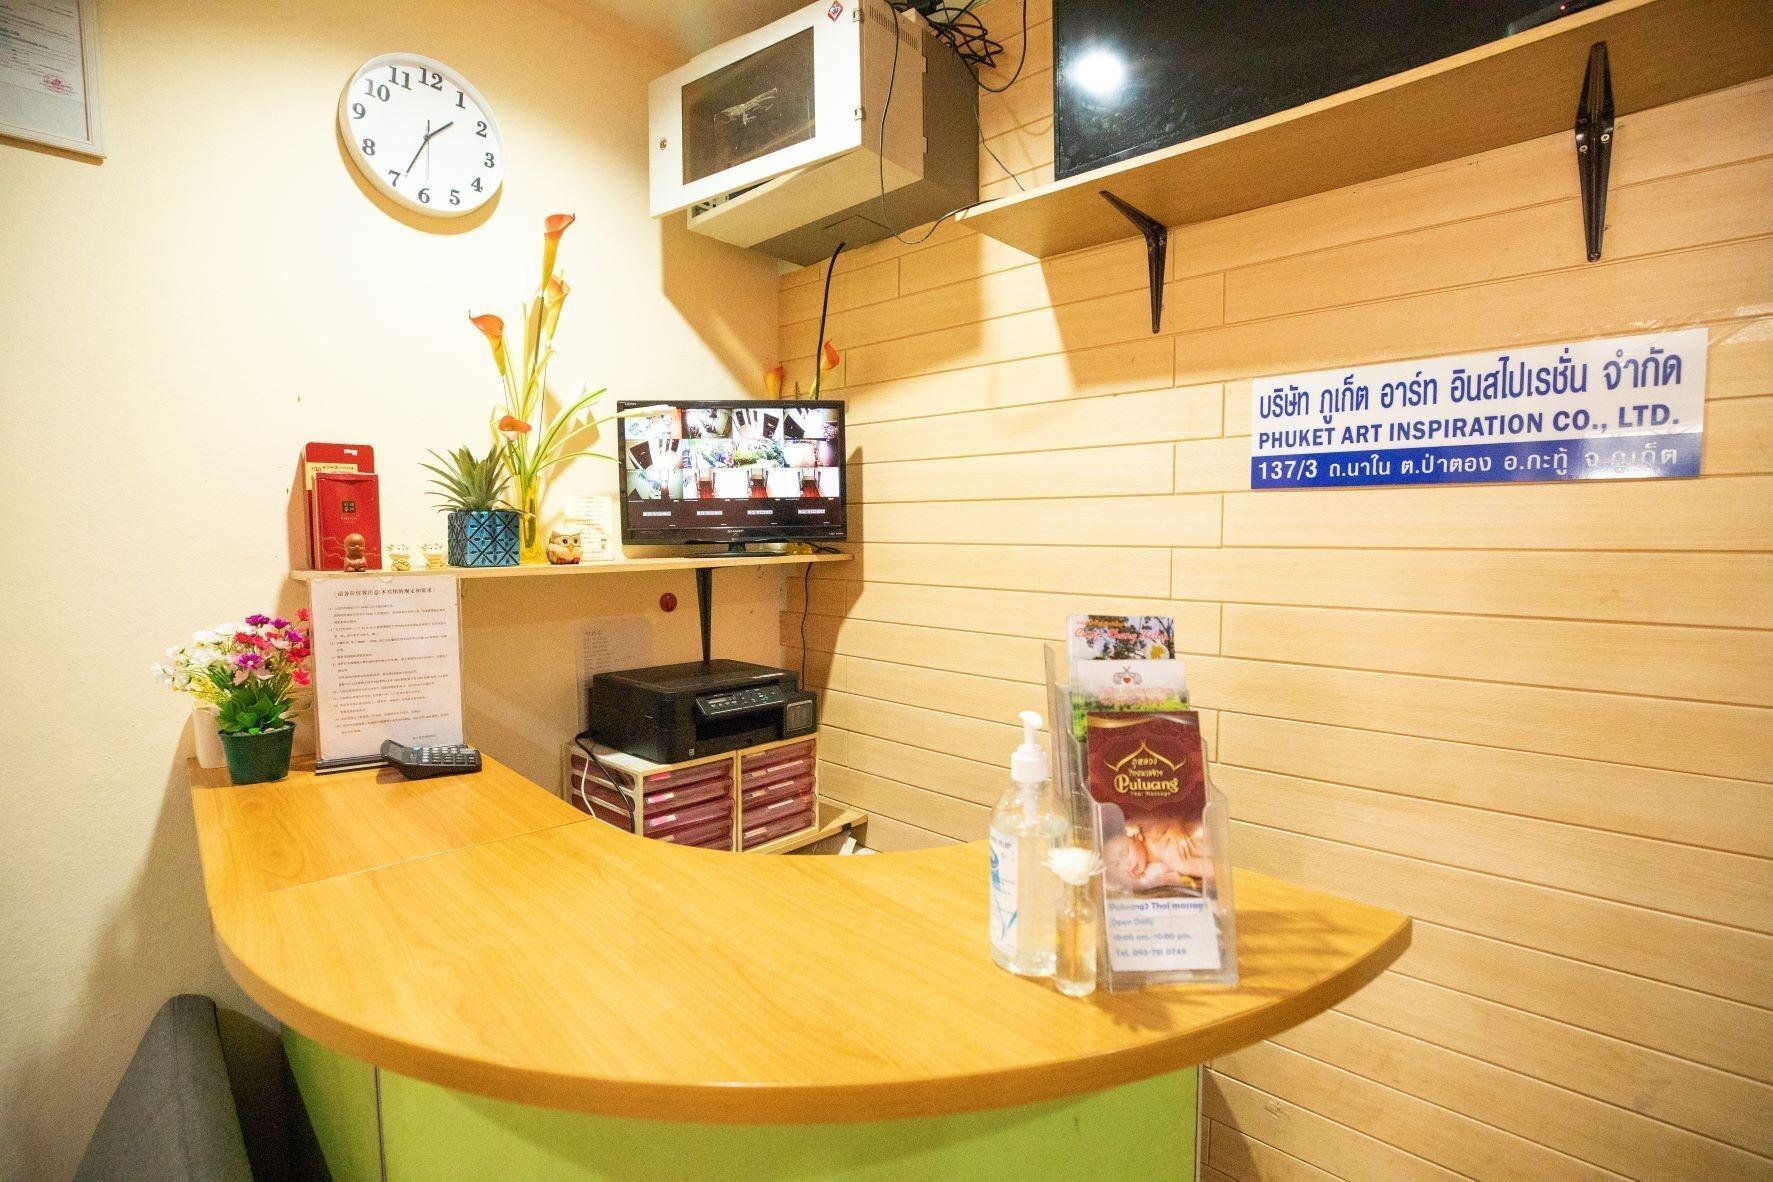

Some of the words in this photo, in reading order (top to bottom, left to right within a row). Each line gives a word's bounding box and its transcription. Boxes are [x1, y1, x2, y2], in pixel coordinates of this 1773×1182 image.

[388, 65, 412, 91] 11
[418, 66, 443, 91] 12
[364, 78, 391, 102] 10
[455, 90, 466, 109] 1
[352, 102, 366, 119] 9
[475, 121, 488, 138] 2
[362, 138, 376, 156] 8
[484, 152, 495, 168] 3
[388, 169, 401, 187] 7
[471, 177, 483, 192] 4
[418, 187, 430, 203] 6
[449, 189, 461, 205] 5
[1259, 385, 1309, 419] บริษัท
[1320, 374, 1369, 424] ภูเก็ต
[1381, 371, 1438, 408] อาร์ท
[1450, 348, 1587, 402] อินสไปเรชั่น
[1603, 347, 1681, 390] จำกัด
[1259, 427, 1335, 449] PHUKET
[1341, 424, 1382, 444] ART
[1390, 412, 1543, 441] INSPIRATION
[1553, 409, 1607, 433] CO.,
[1618, 404, 1679, 428] LTD.
[1258, 459, 1318, 480] 137/3
[1329, 454, 1390, 477] ถ.นาใน
[1401, 454, 1492, 474] ต.ป่าตอง
[1114, 774, 1179, 793] Puluang
